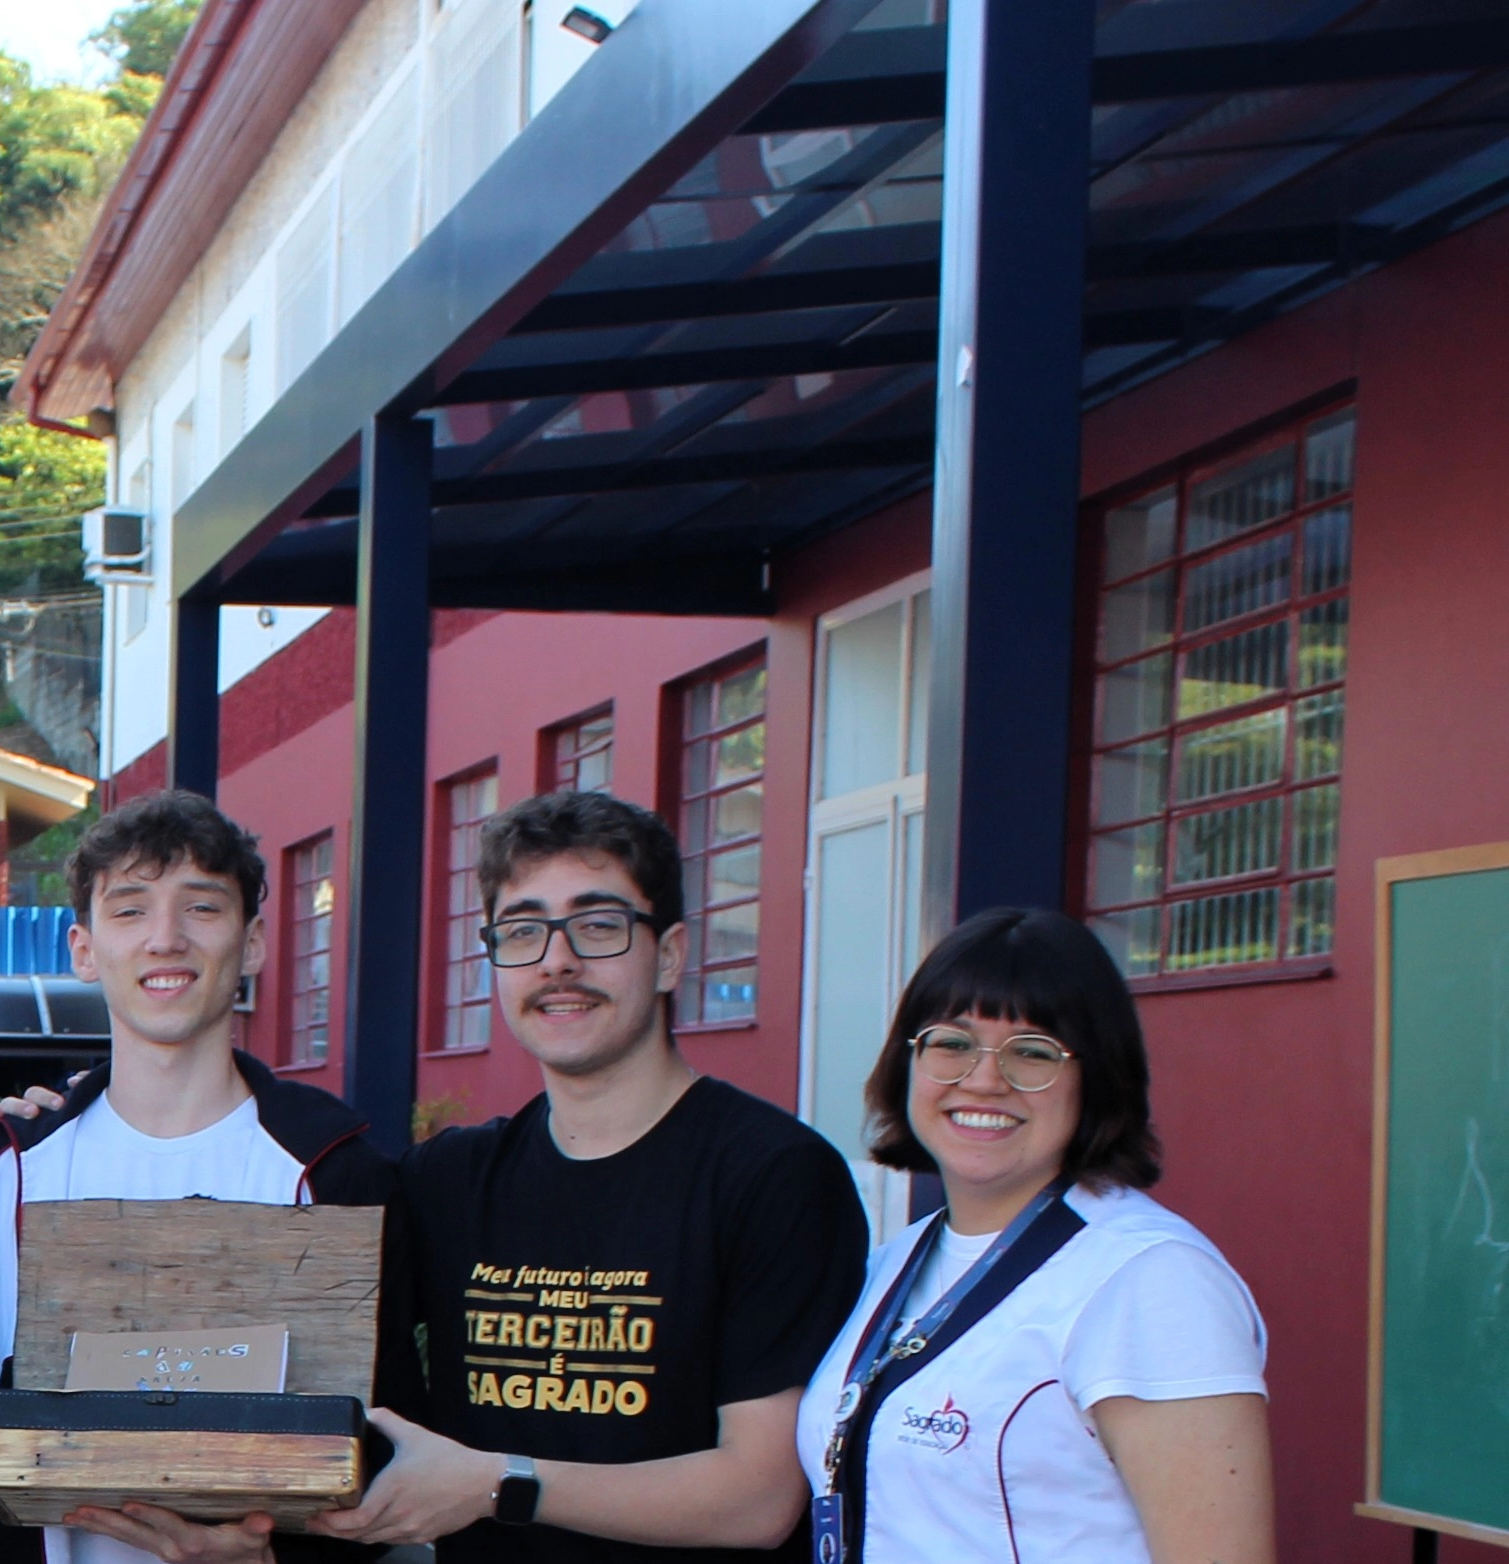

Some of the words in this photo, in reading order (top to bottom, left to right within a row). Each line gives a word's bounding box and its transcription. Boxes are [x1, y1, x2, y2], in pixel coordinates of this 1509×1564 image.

[513, 1265, 582, 1288] futuro
[590, 1269, 651, 1290] agora
[538, 1289, 590, 1309] MEU
[464, 1305, 654, 1353] TERCEIRÃO
[549, 1353, 565, 1375] É
[467, 1371, 647, 1416] SAGRADO
